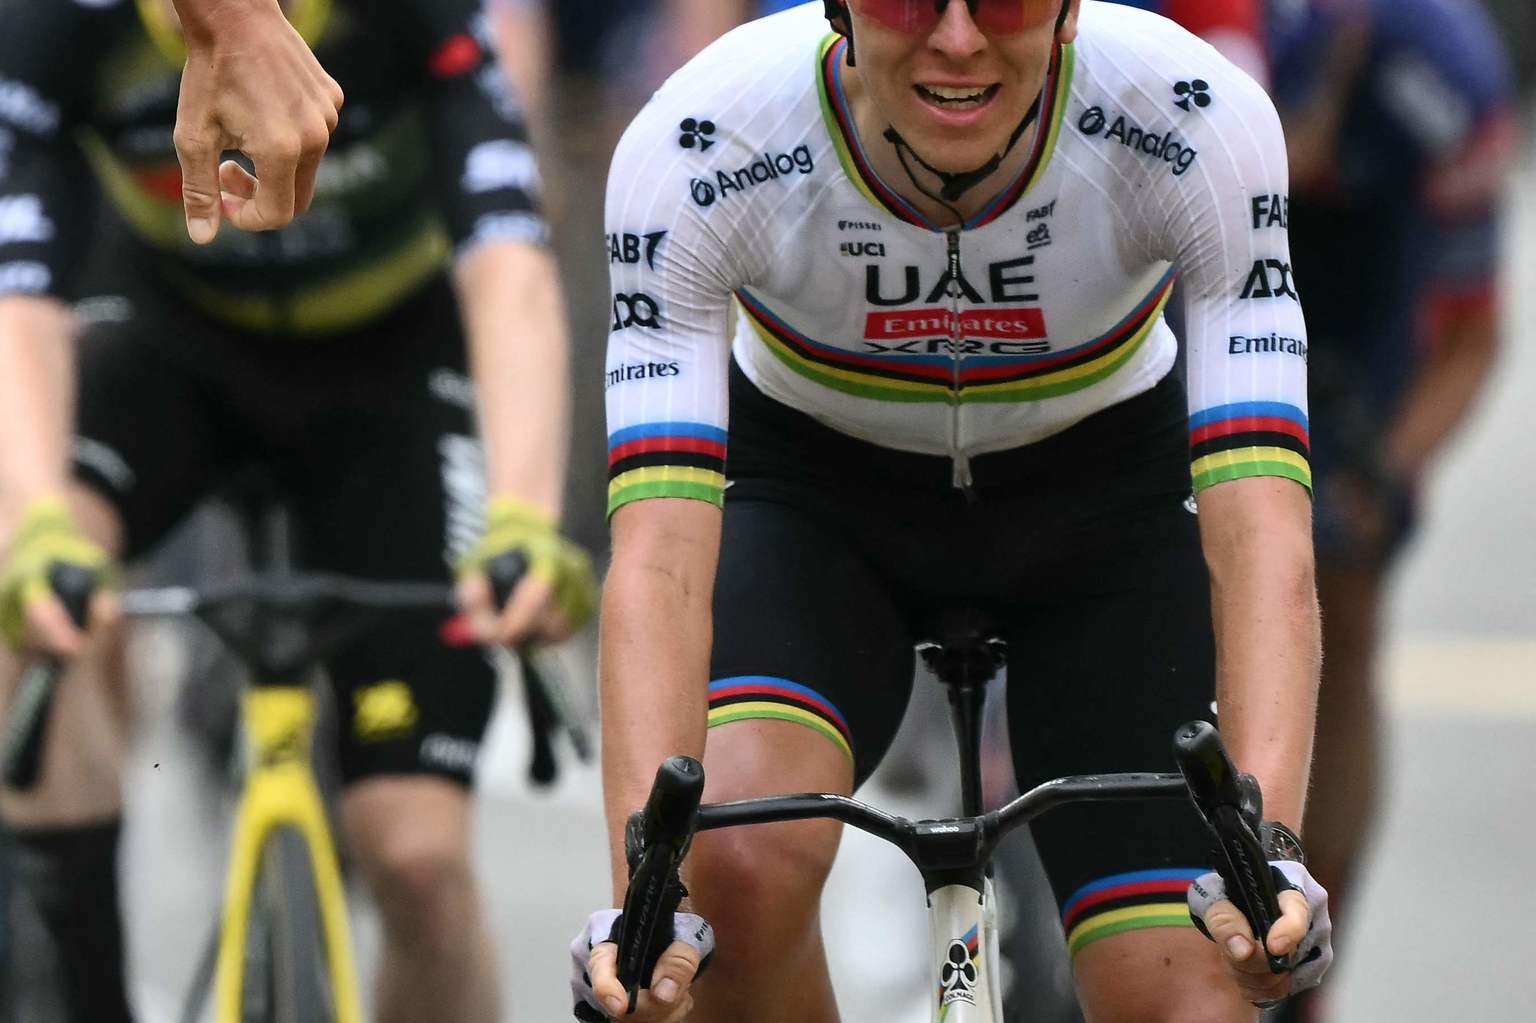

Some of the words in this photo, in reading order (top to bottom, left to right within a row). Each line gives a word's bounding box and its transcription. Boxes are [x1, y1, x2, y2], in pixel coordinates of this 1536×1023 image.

[1104, 116, 1197, 176] Analog
[716, 144, 814, 198] Analog
[848, 242, 885, 257] UCI
[866, 255, 1040, 306] UAE
[884, 315, 1029, 334] Emirates
[864, 339, 1051, 355] XRG
[1228, 333, 1307, 364] Emirat
[607, 360, 680, 388] mirates
